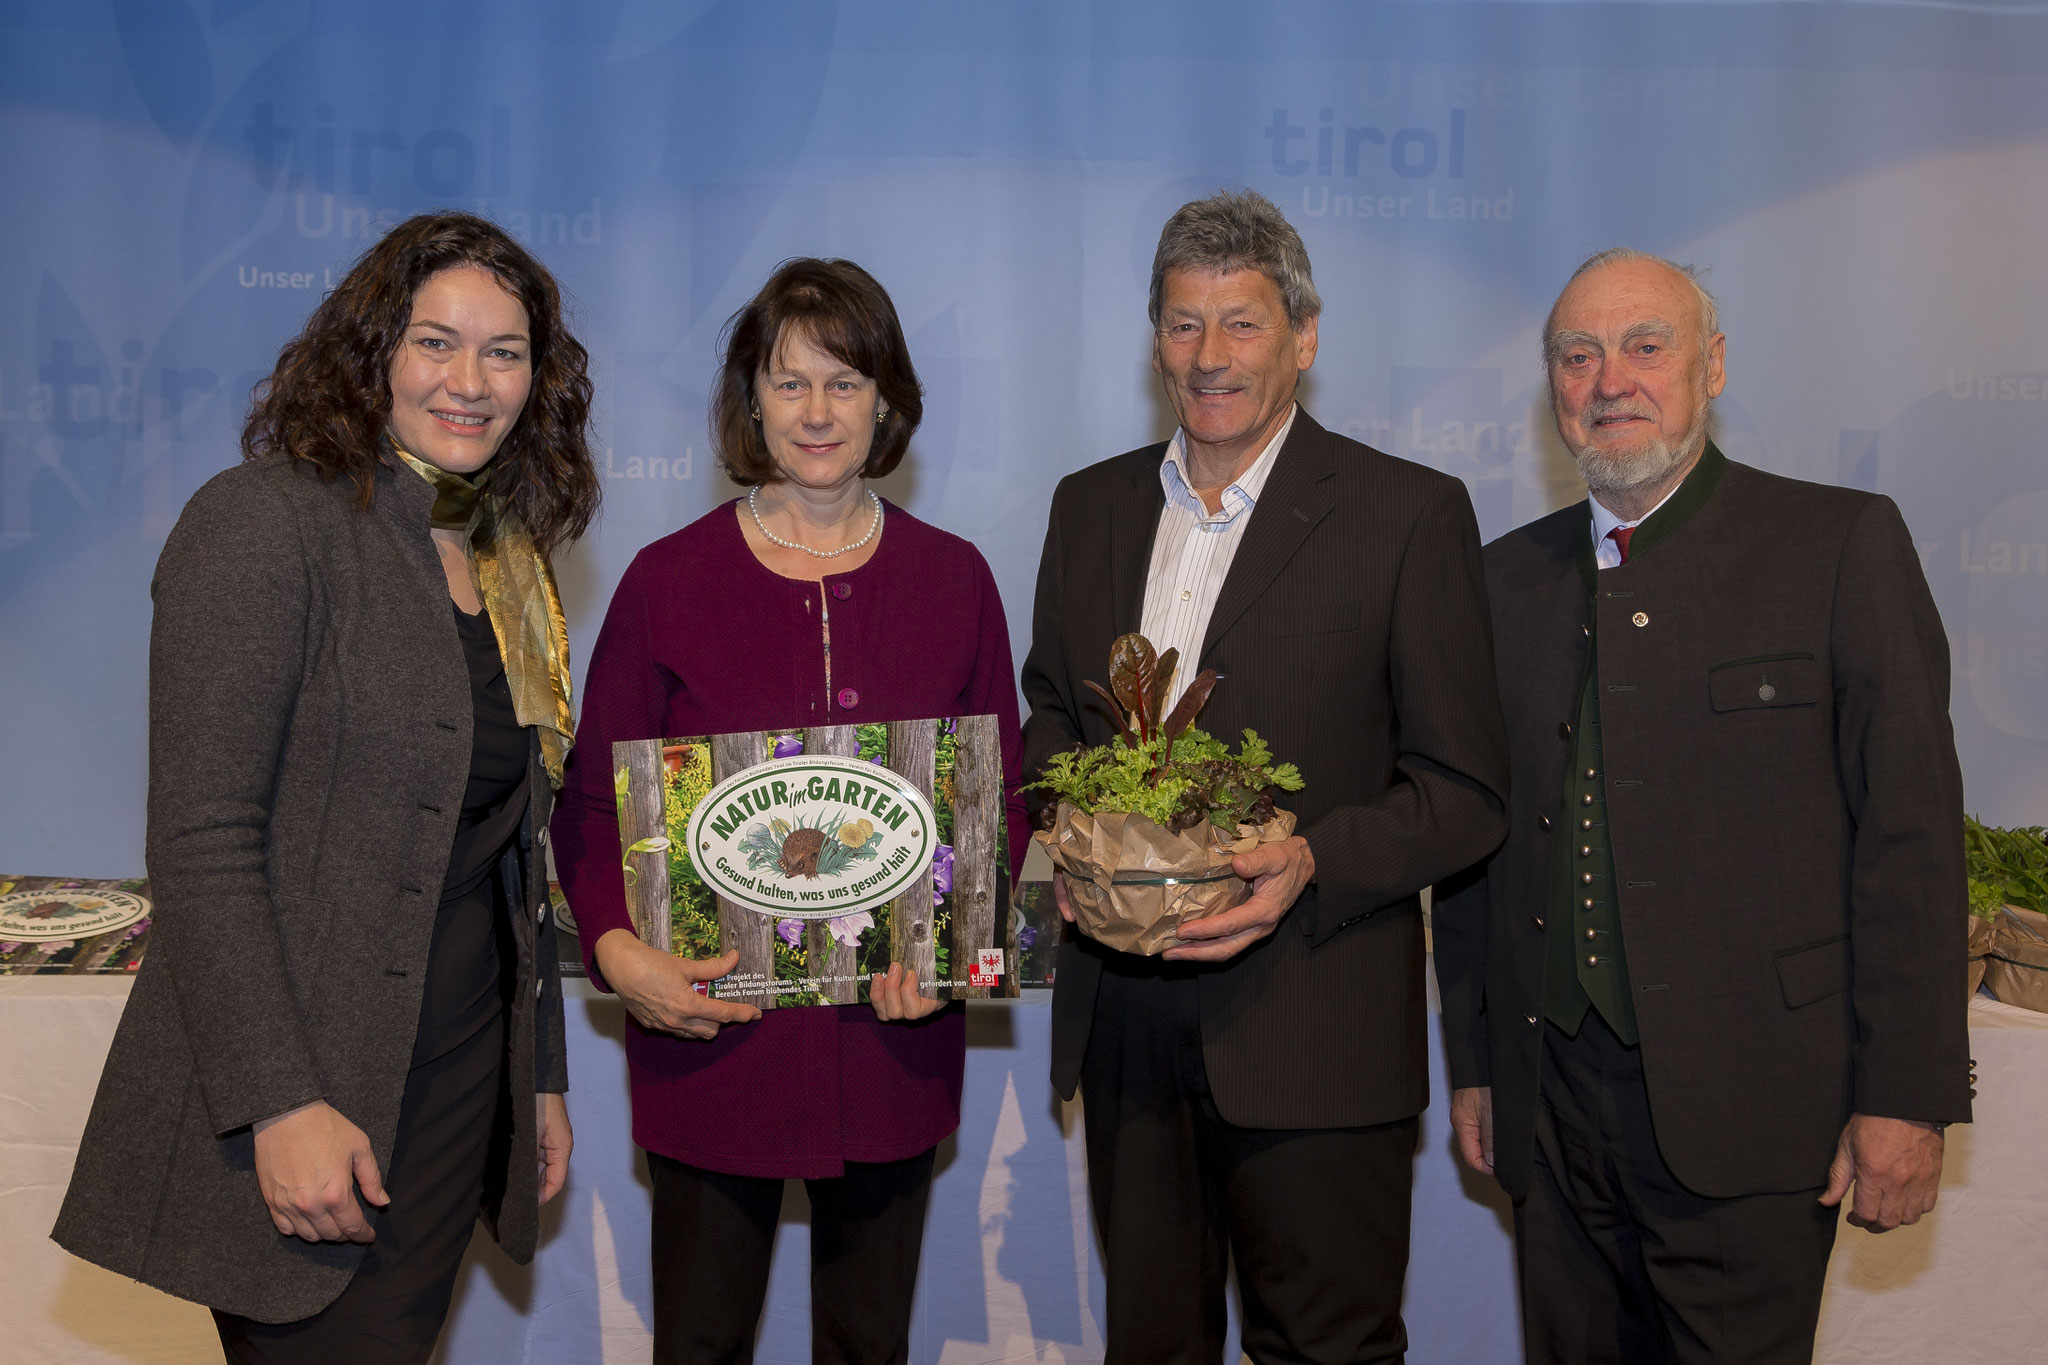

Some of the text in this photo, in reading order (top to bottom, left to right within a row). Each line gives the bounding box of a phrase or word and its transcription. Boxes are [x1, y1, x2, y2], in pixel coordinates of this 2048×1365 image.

[243, 101, 511, 198] tirol
[1264, 107, 1467, 180] tirol
[1302, 185, 1515, 221] Unser Land
[238, 265, 315, 289] Unser
[1411, 406, 1533, 454] Land
[605, 446, 693, 480] Land
[710, 776, 910, 841] NATUR im GARTEN
[715, 845, 912, 902] Gesund halten, was uns gesund hält
[714, 982, 737, 990] Tiroler
[738, 979, 793, 989] Bildungsforums
[798, 977, 820, 985] Verein
[821, 975, 832, 983] für
[833, 974, 856, 982] Kultur
[856, 973, 871, 981] und
[714, 985, 819, 998] Bereich Forum blühendes Tirol
[726, 973, 751, 983] Projekt
[752, 972, 765, 980] des
[971, 973, 995, 982] tirol
